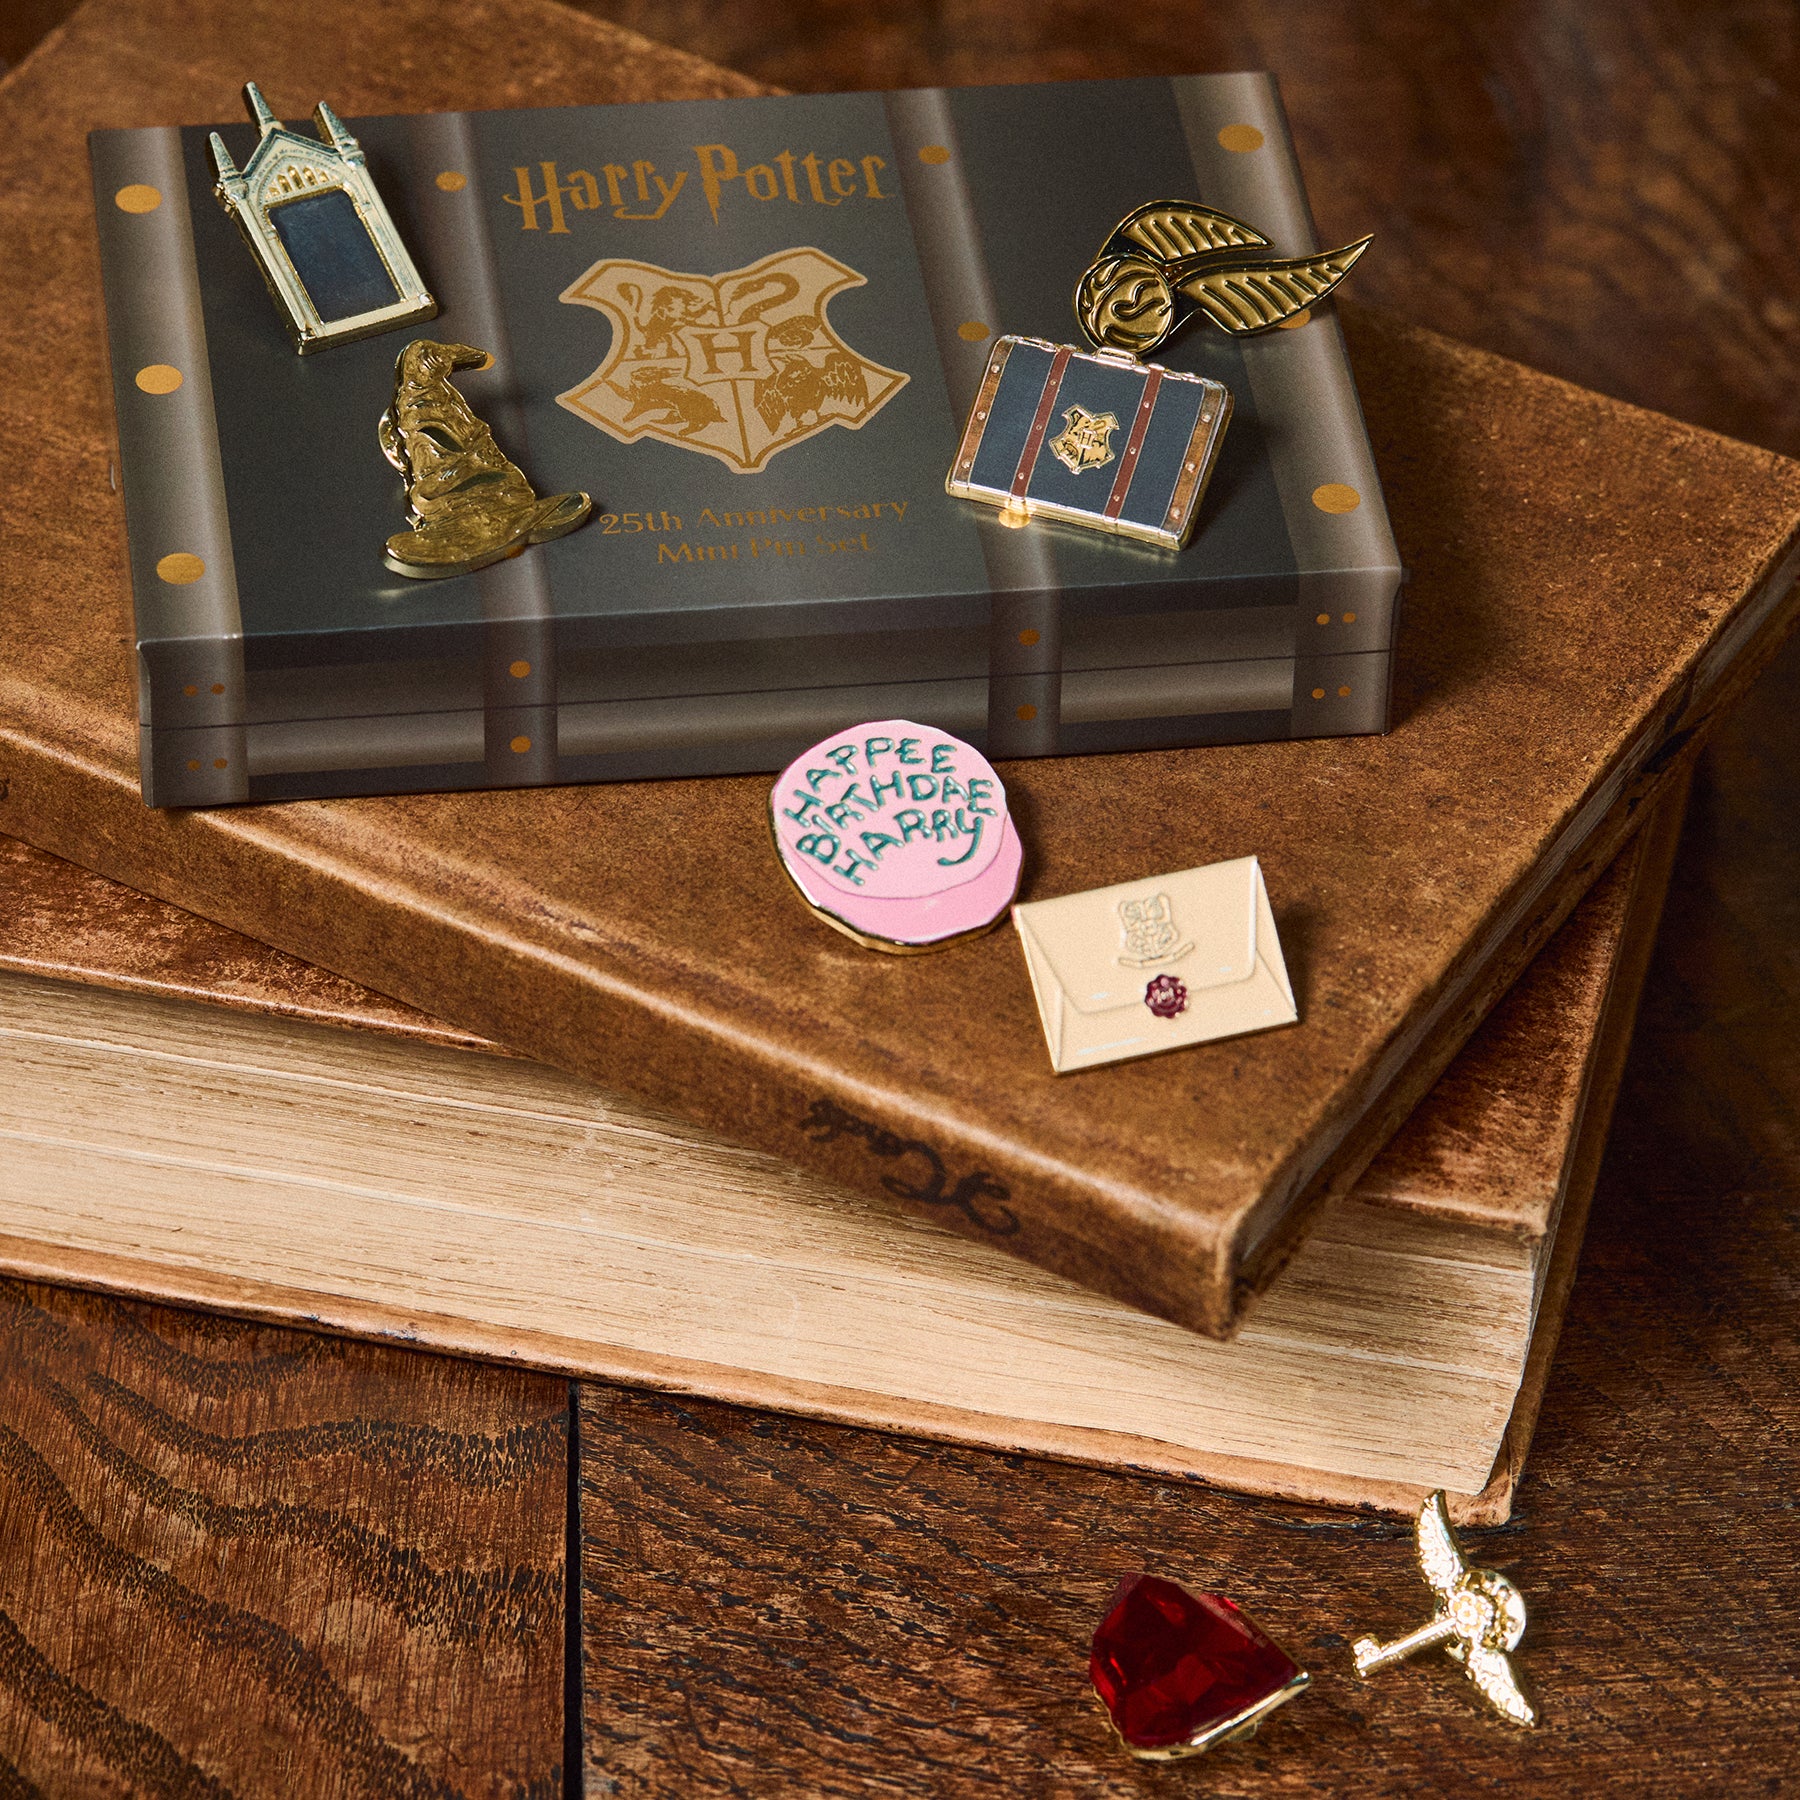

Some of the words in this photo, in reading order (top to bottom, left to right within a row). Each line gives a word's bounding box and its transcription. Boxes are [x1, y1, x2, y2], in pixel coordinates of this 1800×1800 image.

[502, 161, 689, 234] Harry
[692, 143, 888, 226] Potter
[690, 330, 758, 374] H
[599, 511, 682, 535] 25th
[698, 500, 908, 528] Anniversary
[656, 541, 739, 564] Mini
[750, 536, 807, 558] Pin
[815, 532, 876, 555] Set
[783, 736, 958, 829] HAPPEE
[795, 770, 998, 865] BIRTHDAE
[832, 807, 984, 887] HARRY
